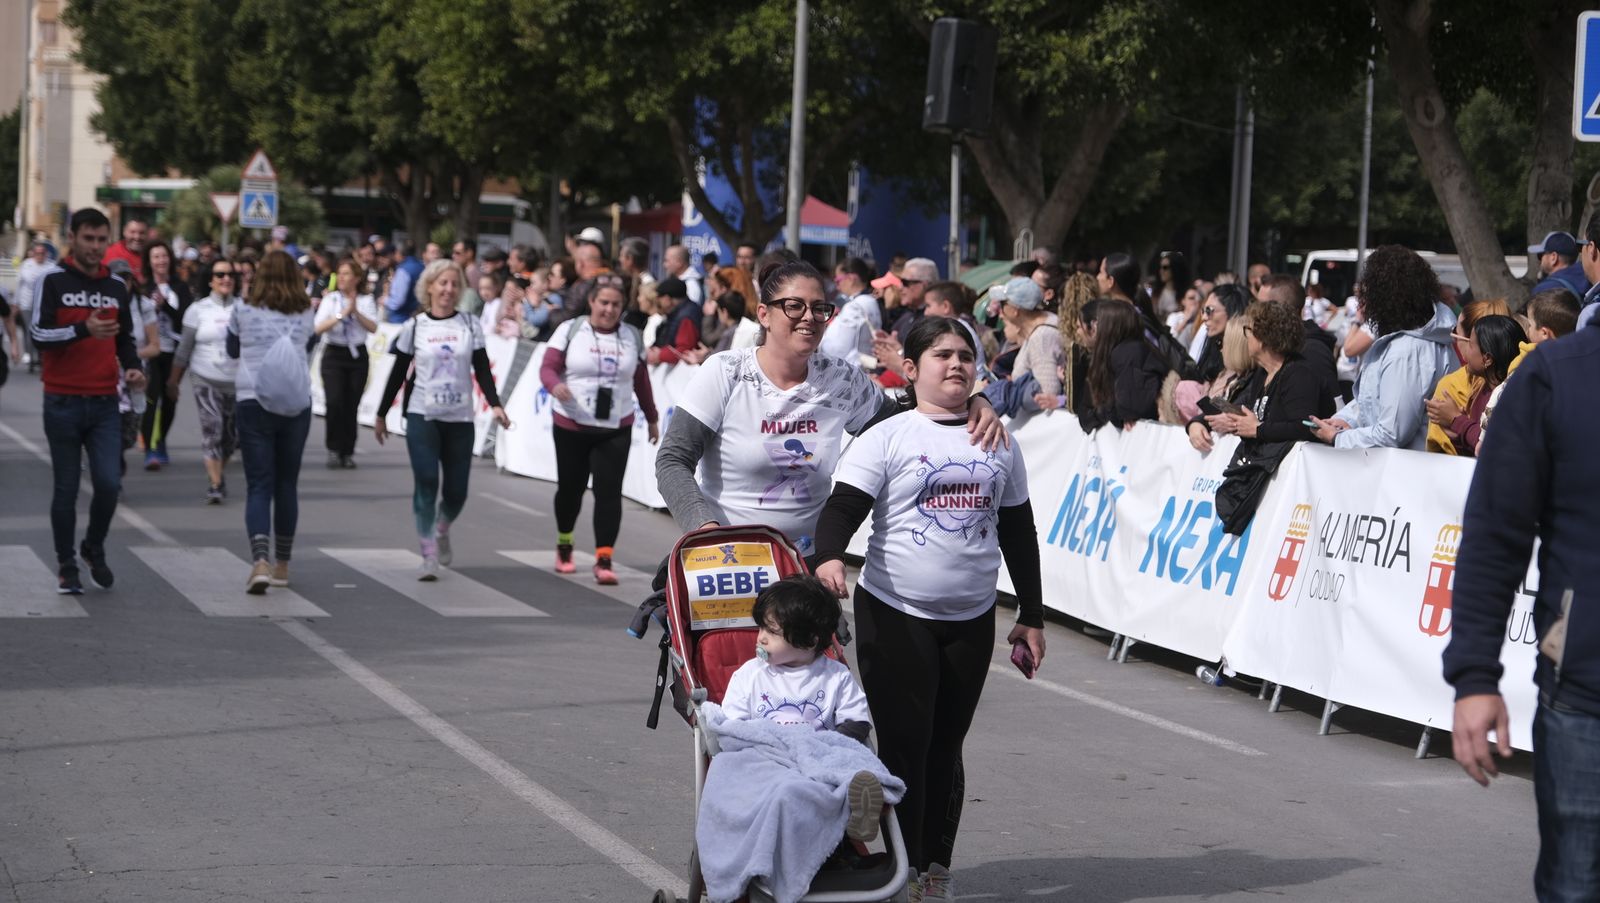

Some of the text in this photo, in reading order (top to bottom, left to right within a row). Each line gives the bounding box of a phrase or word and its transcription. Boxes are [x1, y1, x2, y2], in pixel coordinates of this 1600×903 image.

[61, 290, 119, 309] addas
[760, 419, 819, 435] MUJER
[937, 482, 980, 495] MINI
[925, 495, 992, 509] RUNNER
[1316, 506, 1412, 573] ALMERÍA
[696, 567, 769, 597] BEBÉ
[1308, 569, 1346, 603] CIUDAD
